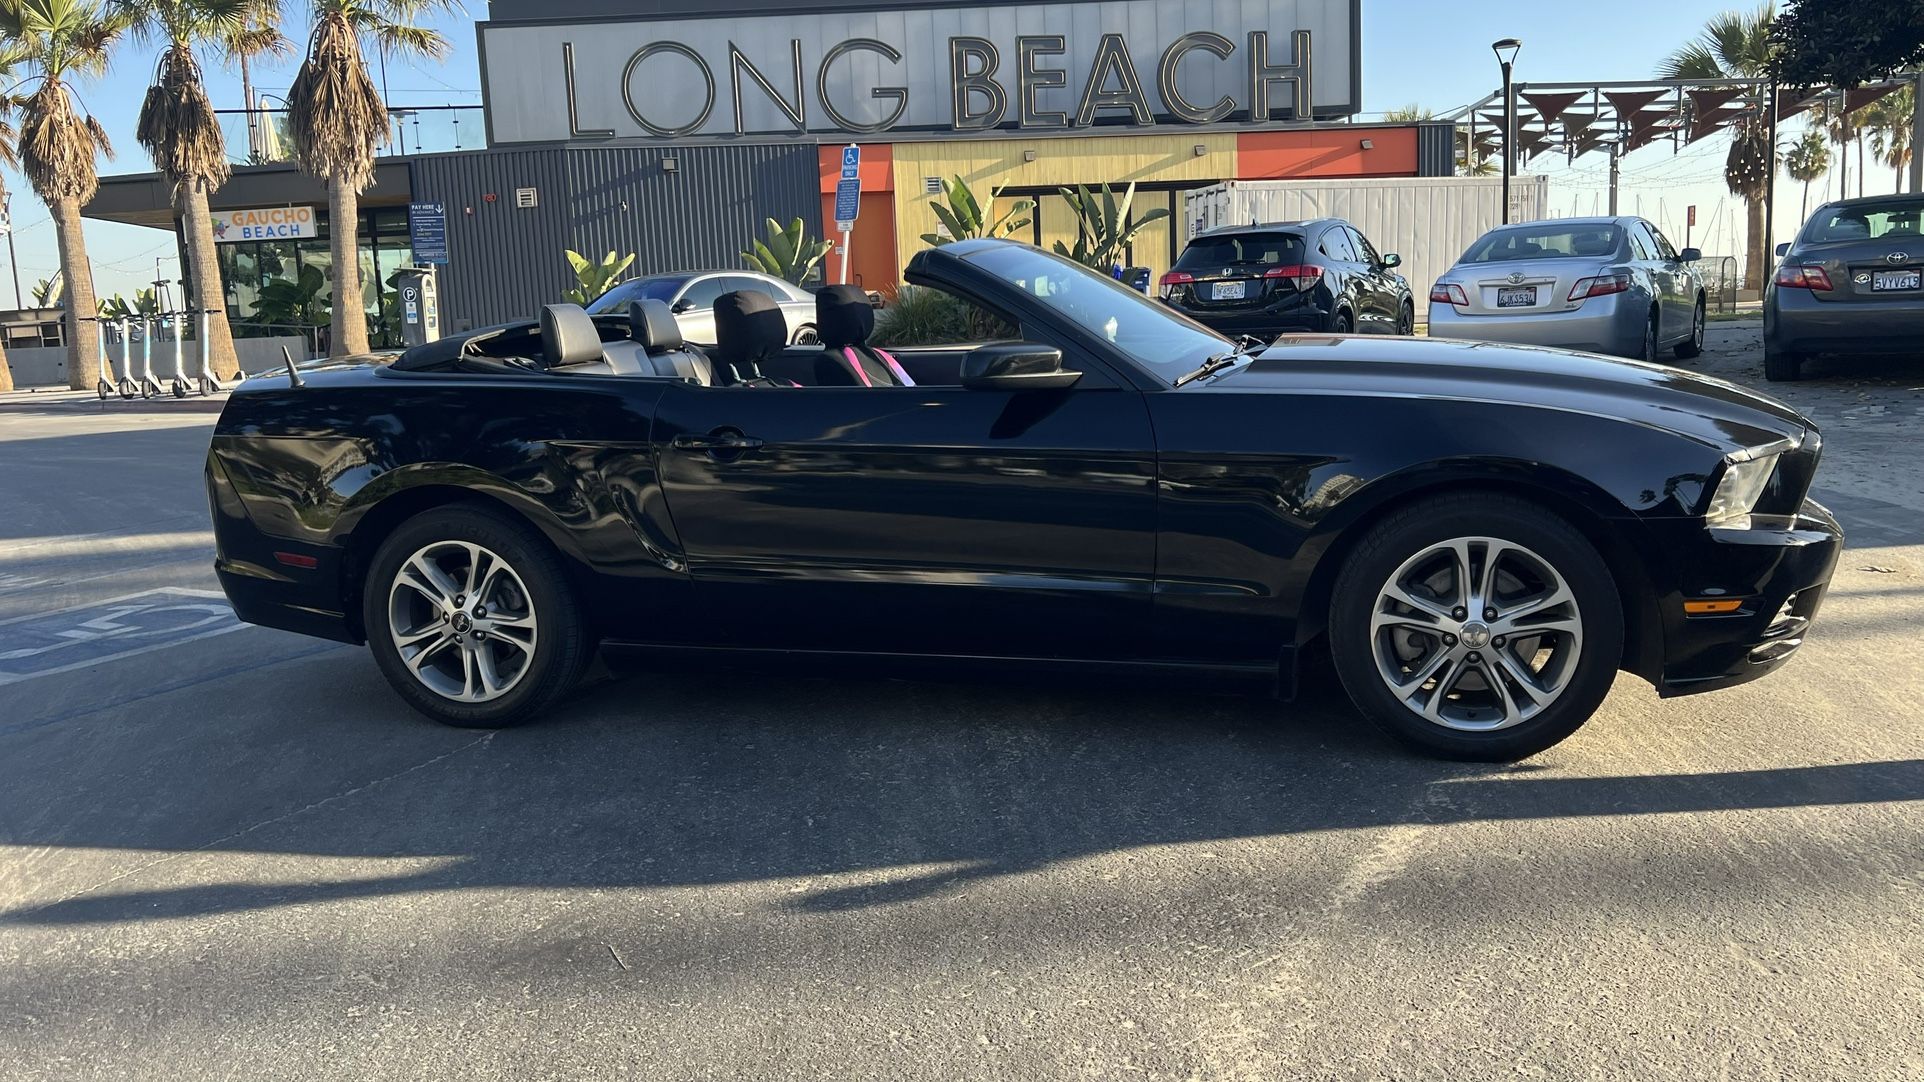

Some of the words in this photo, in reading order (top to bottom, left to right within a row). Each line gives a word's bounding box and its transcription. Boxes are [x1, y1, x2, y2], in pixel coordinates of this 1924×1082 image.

[562, 37, 909, 139] LONG
[948, 29, 1314, 131] BEACH
[231, 207, 310, 227] GAUCHO
[242, 223, 300, 239] BEACH
[1875, 276, 1919, 288] 5VYV619
[406, 289, 414, 300] P
